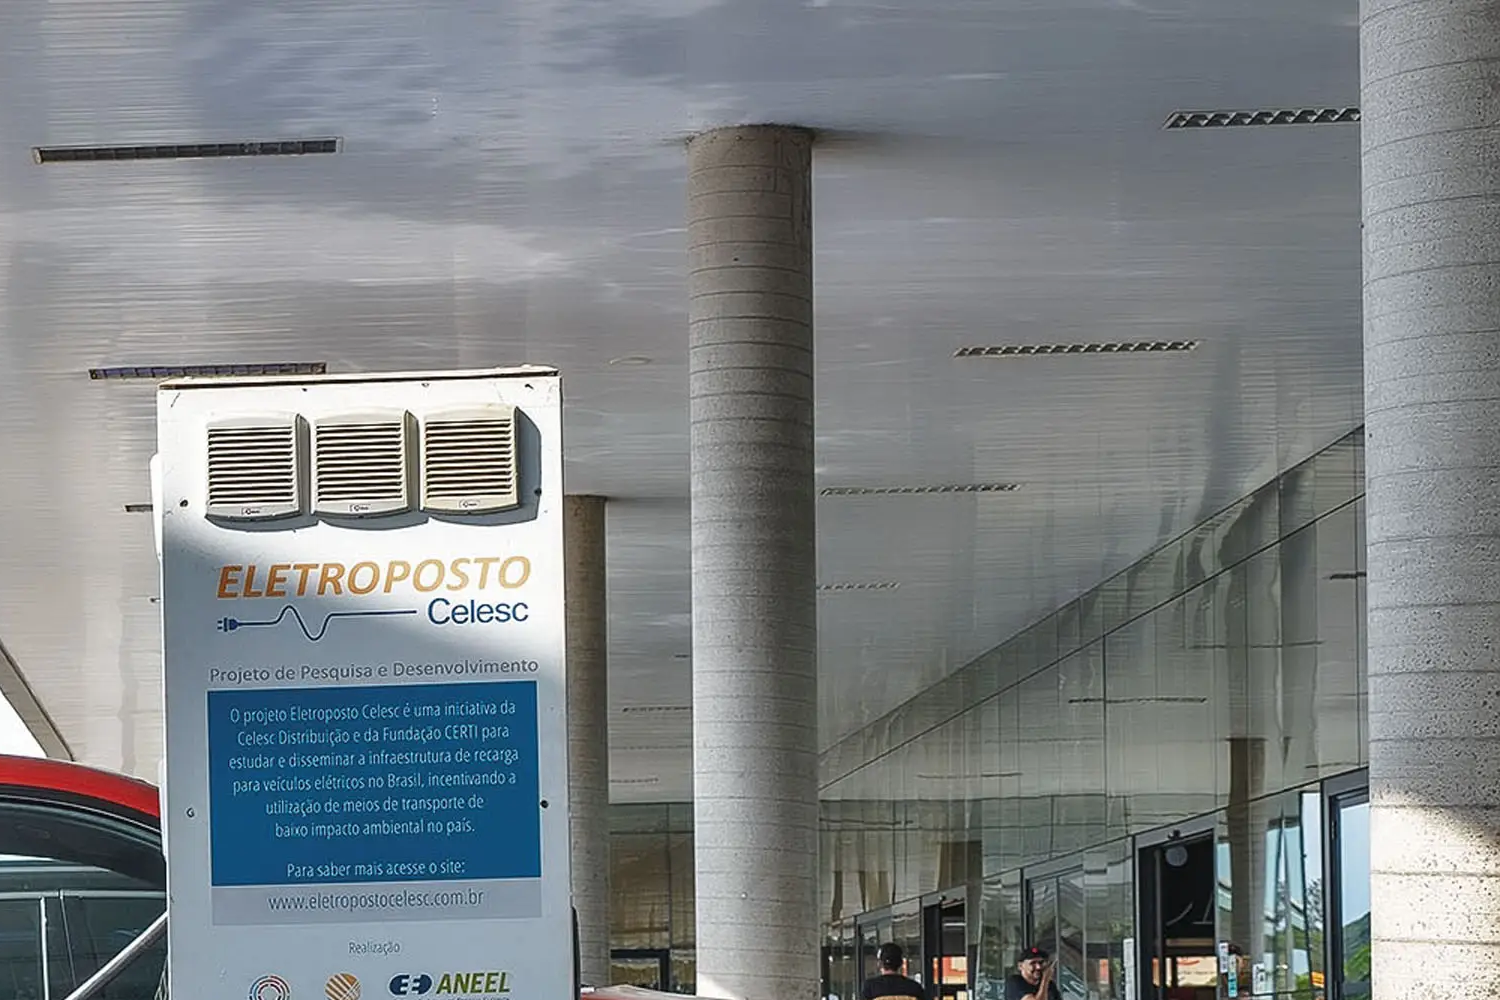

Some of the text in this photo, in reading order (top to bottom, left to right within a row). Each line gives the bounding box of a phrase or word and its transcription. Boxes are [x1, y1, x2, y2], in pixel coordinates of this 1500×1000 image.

[217, 556, 531, 598] ELETROPOSTO
[428, 598, 529, 625] Celesc
[210, 659, 539, 684] Projeto de Pesquisa e Desenvolvimento
[230, 700, 516, 726] O projeto Eletroposto Celesc é uma iniciativa da
[237, 724, 510, 747] Celesc Distribuição e da Fundação CERTI para
[229, 748, 519, 769] estudar e disseminar a infraestrutura de recarga
[233, 780, 261, 796] para
[263, 776, 312, 792] veículos
[314, 775, 366, 791] elétricos
[368, 777, 385, 789] no
[428, 770, 504, 786] incentivando
[507, 772, 517, 785] a
[265, 794, 485, 817] utilização de meios de transporte de
[275, 817, 475, 840] baixo impacto ambiental no país.
[287, 858, 466, 877] Para saber mais acesse o site:
[268, 889, 484, 911] www.eletropostocelesc.com.br
[348, 941, 401, 957] Realização
[436, 971, 511, 994] ANEEL
